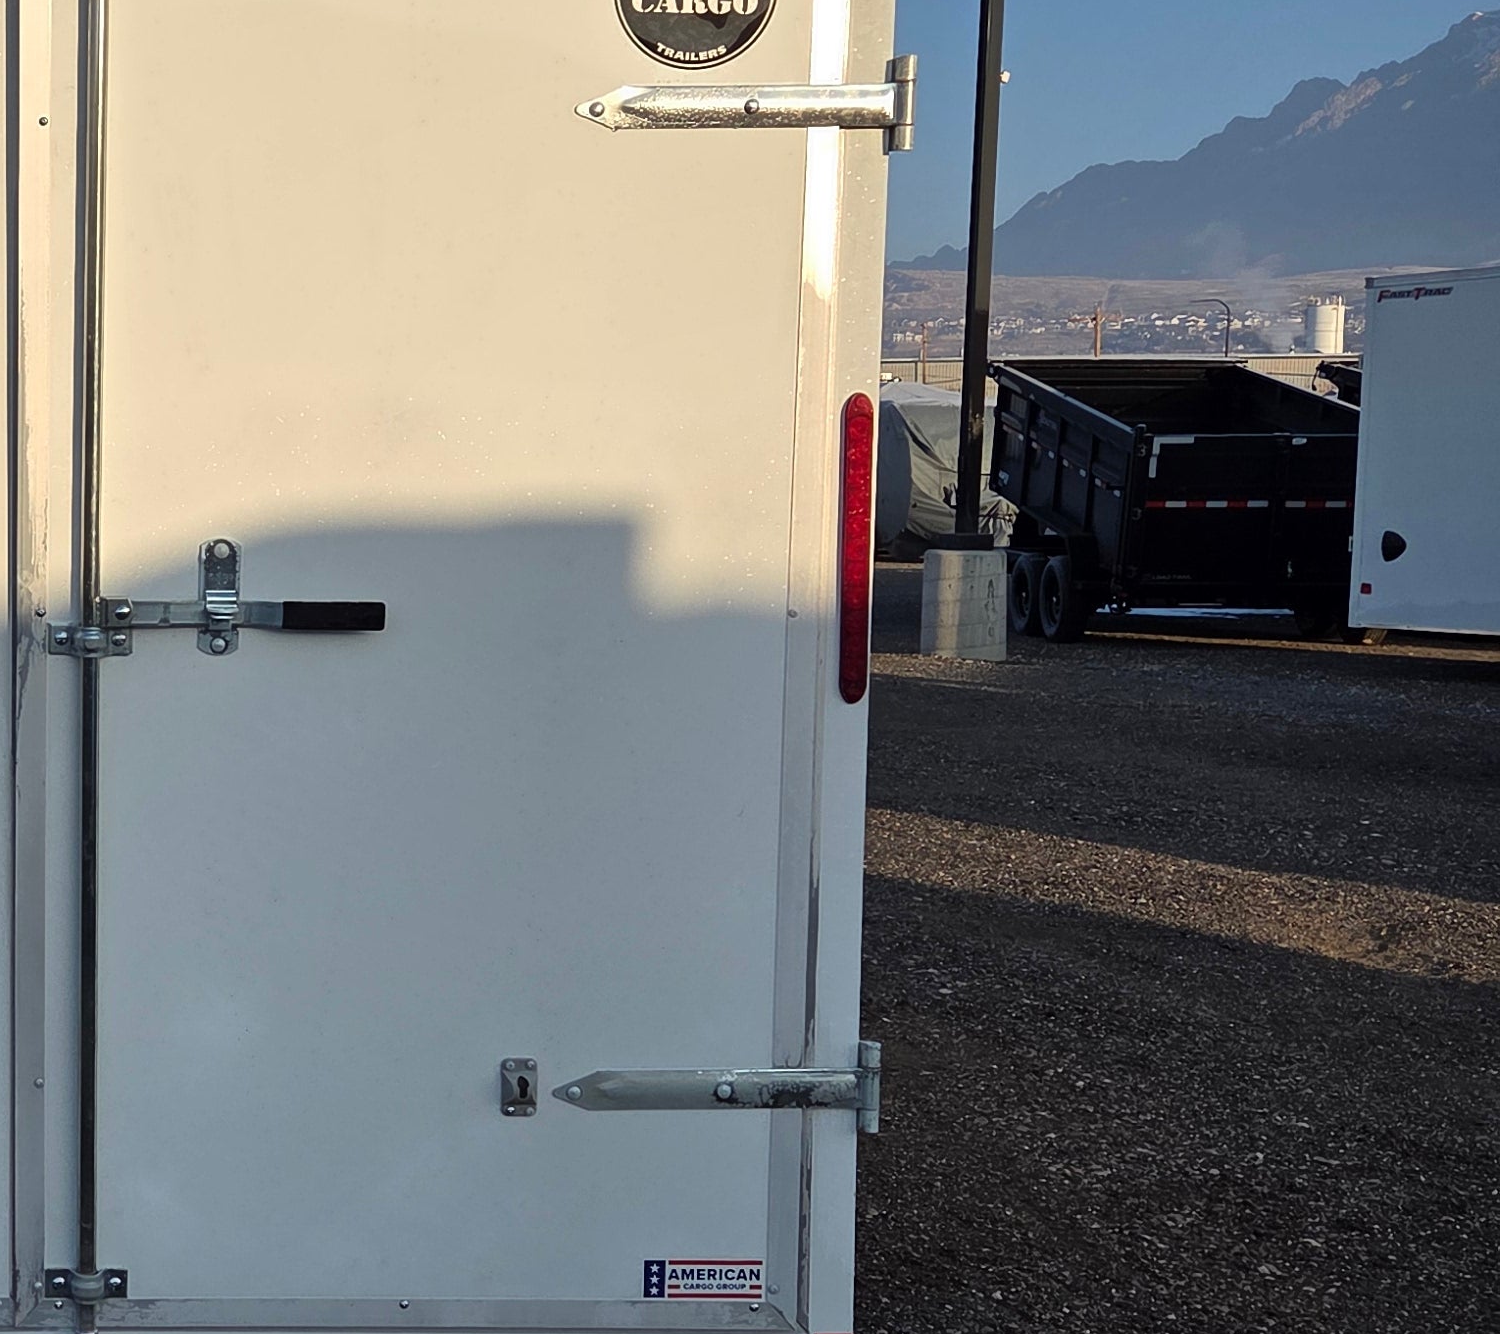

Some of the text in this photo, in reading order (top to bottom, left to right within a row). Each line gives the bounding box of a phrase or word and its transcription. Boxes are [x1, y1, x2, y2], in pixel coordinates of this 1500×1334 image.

[656, 42, 727, 61] TRAILERS
[668, 1268, 761, 1281] AMERICAN
[683, 1283, 746, 1291] CARGO GROUP
